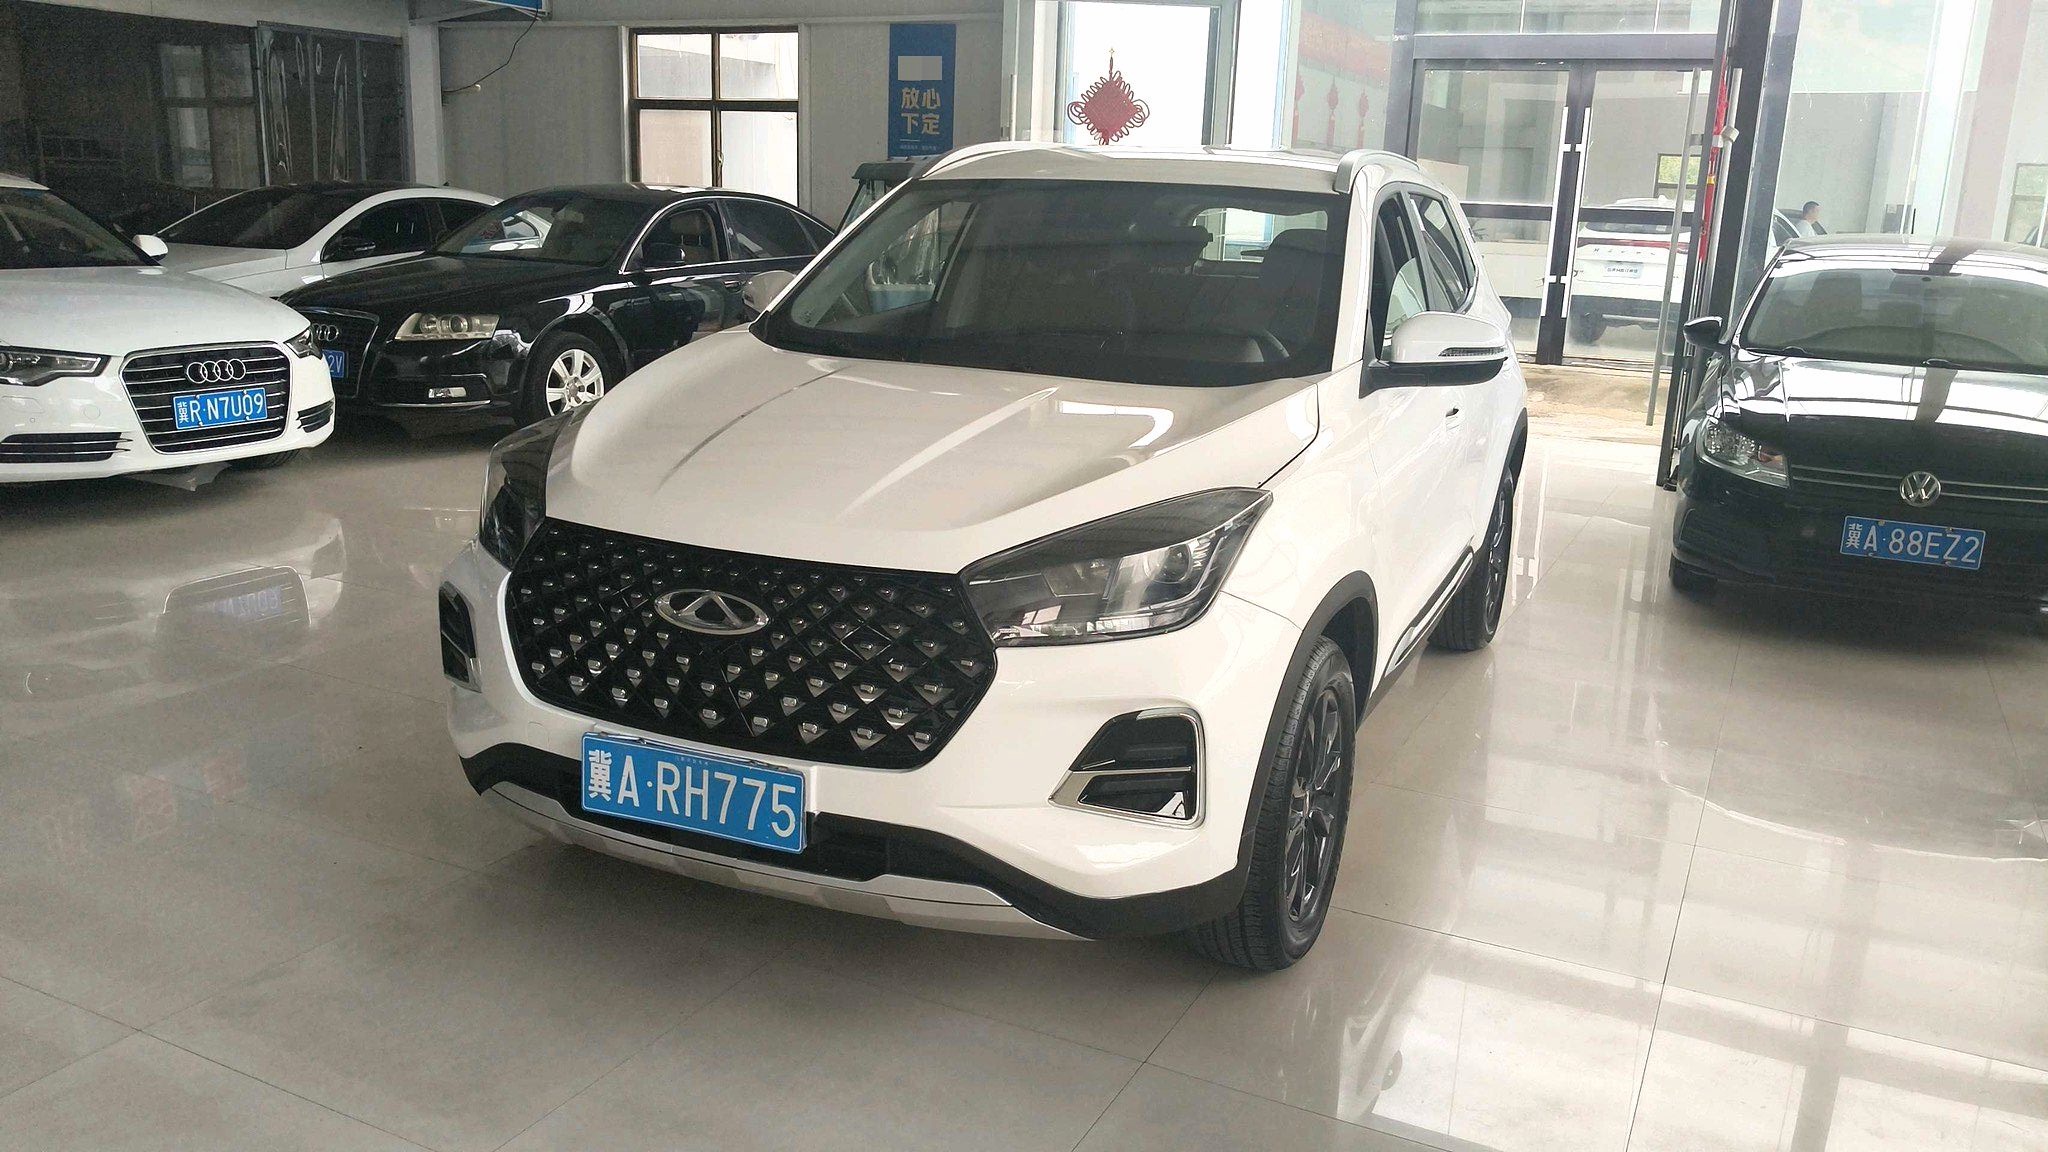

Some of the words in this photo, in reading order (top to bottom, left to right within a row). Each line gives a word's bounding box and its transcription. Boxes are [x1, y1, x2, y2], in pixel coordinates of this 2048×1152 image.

[901, 87, 941, 109] 放心
[901, 112, 940, 135] 下定
[588, 749, 797, 839] 冀A·RH775
